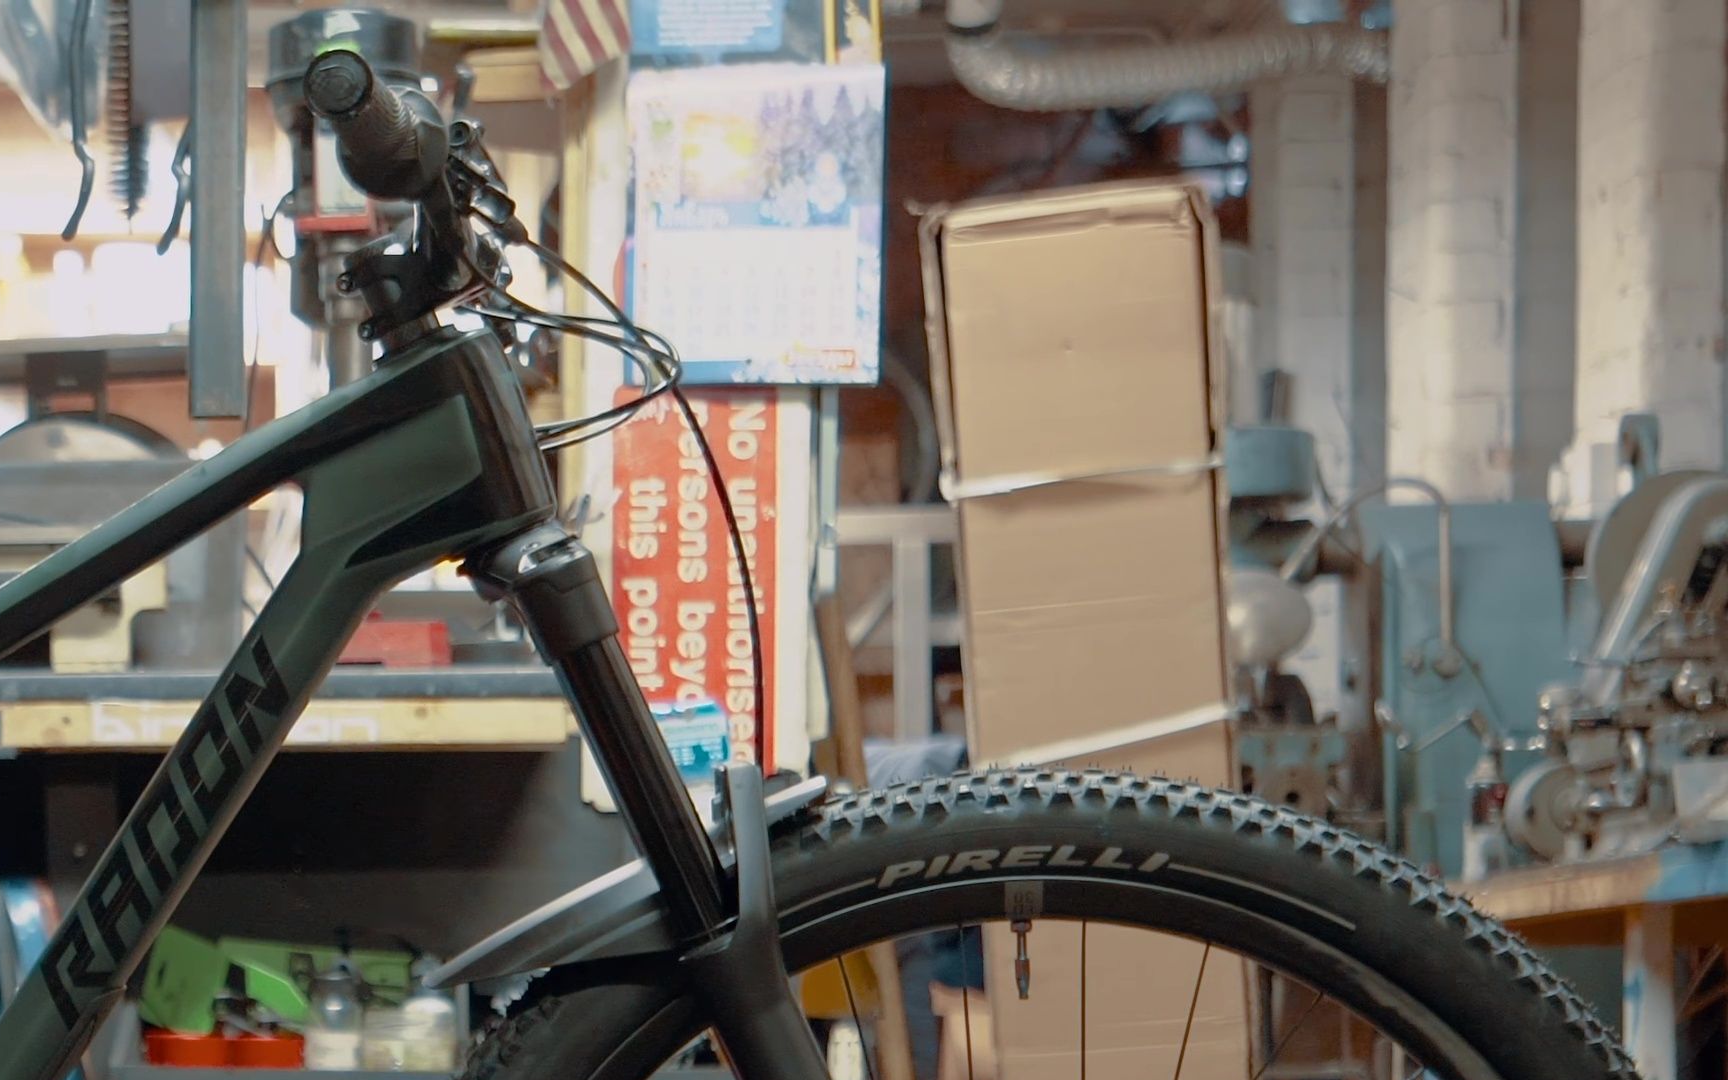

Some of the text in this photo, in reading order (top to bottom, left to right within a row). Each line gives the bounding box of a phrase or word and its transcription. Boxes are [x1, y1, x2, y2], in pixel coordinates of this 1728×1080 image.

[727, 402, 766, 460] No
[622, 478, 667, 692] this point
[671, 601, 715, 710] beyo
[40, 635, 291, 1032] RADON
[877, 844, 1171, 890] PIRELLI
